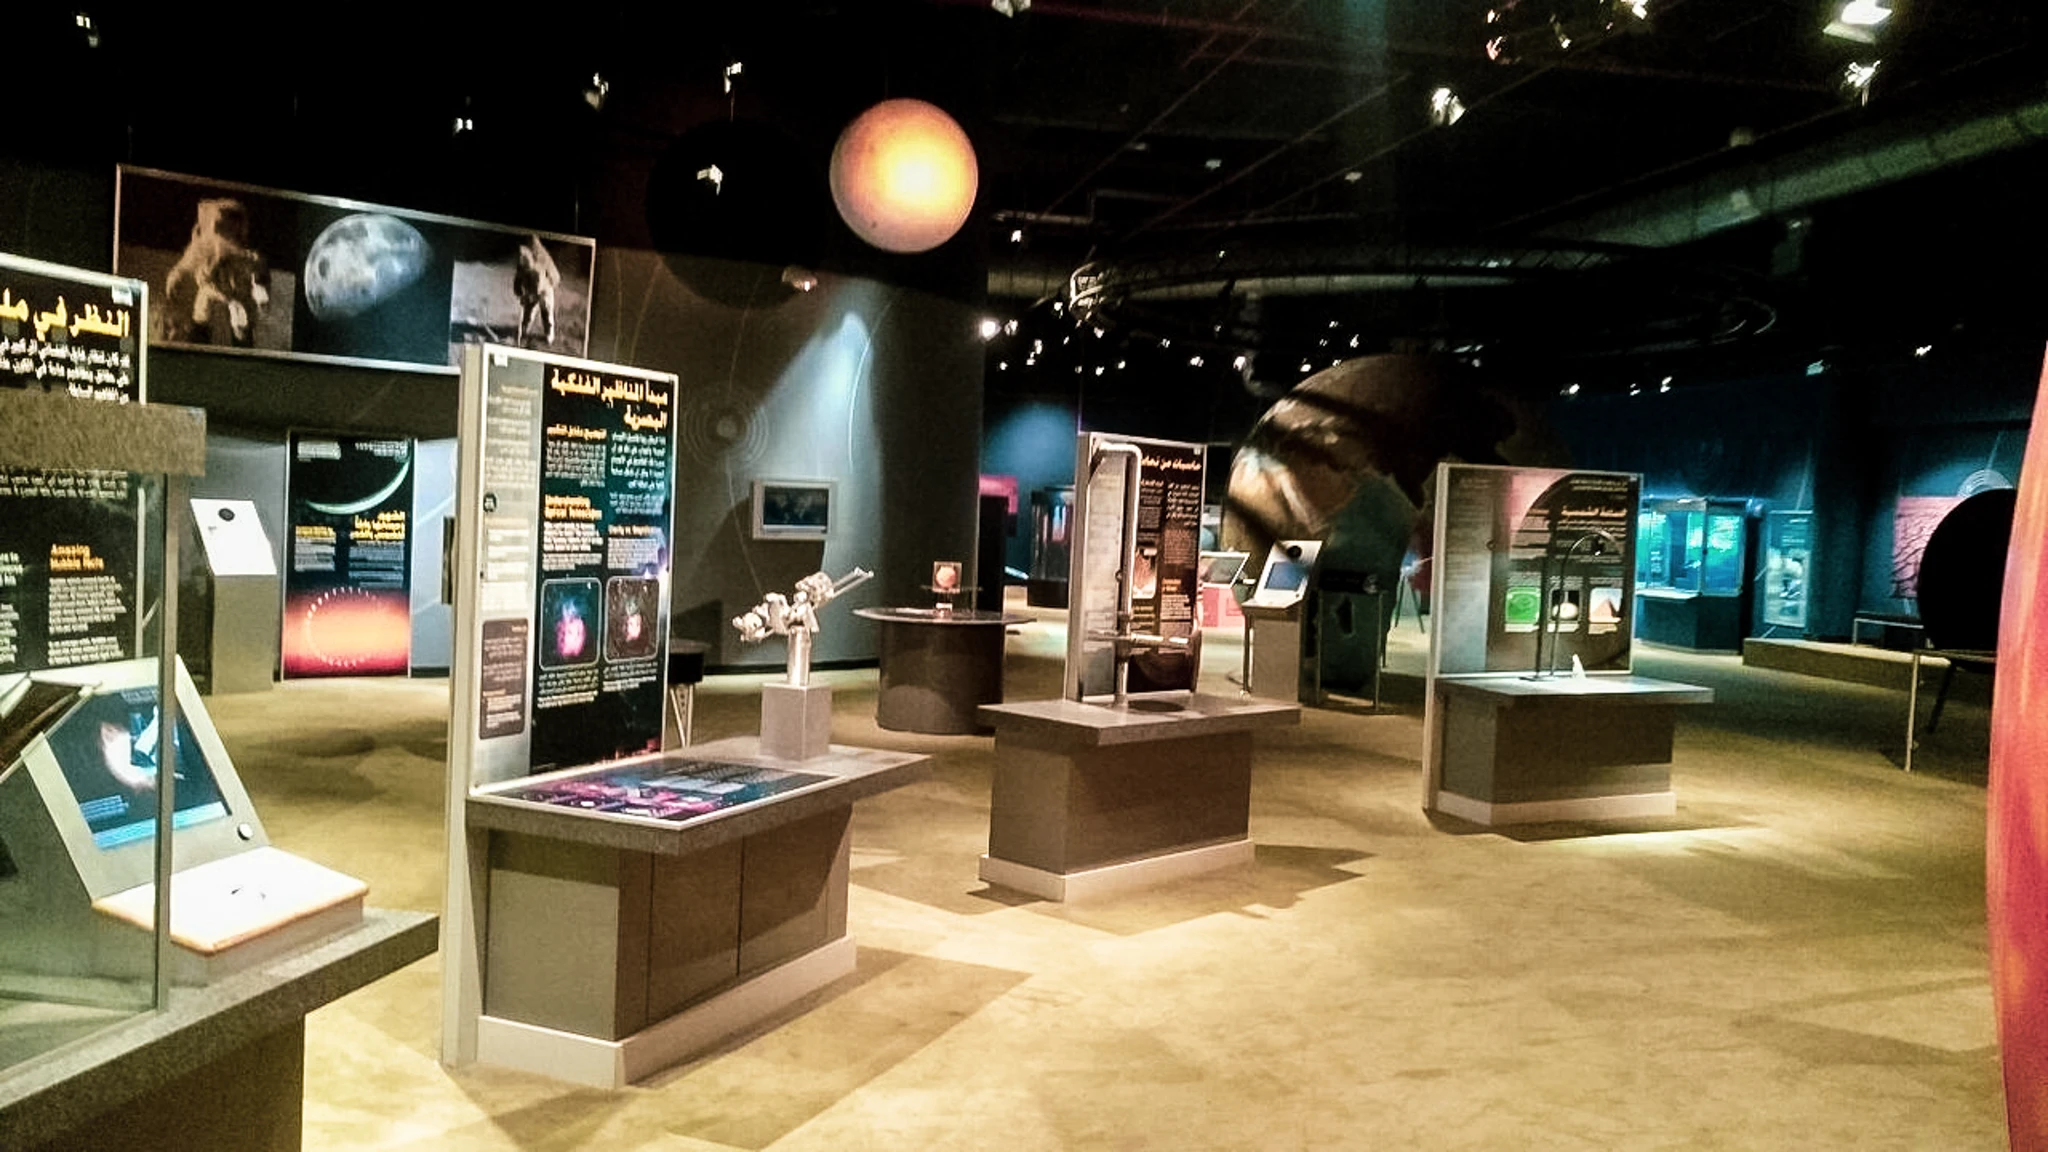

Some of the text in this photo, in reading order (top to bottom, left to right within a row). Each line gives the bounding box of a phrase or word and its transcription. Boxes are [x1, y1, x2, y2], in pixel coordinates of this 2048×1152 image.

[33, 295, 67, 342] في
[68, 303, 130, 338] النظر
[551, 368, 600, 396] الفلكية
